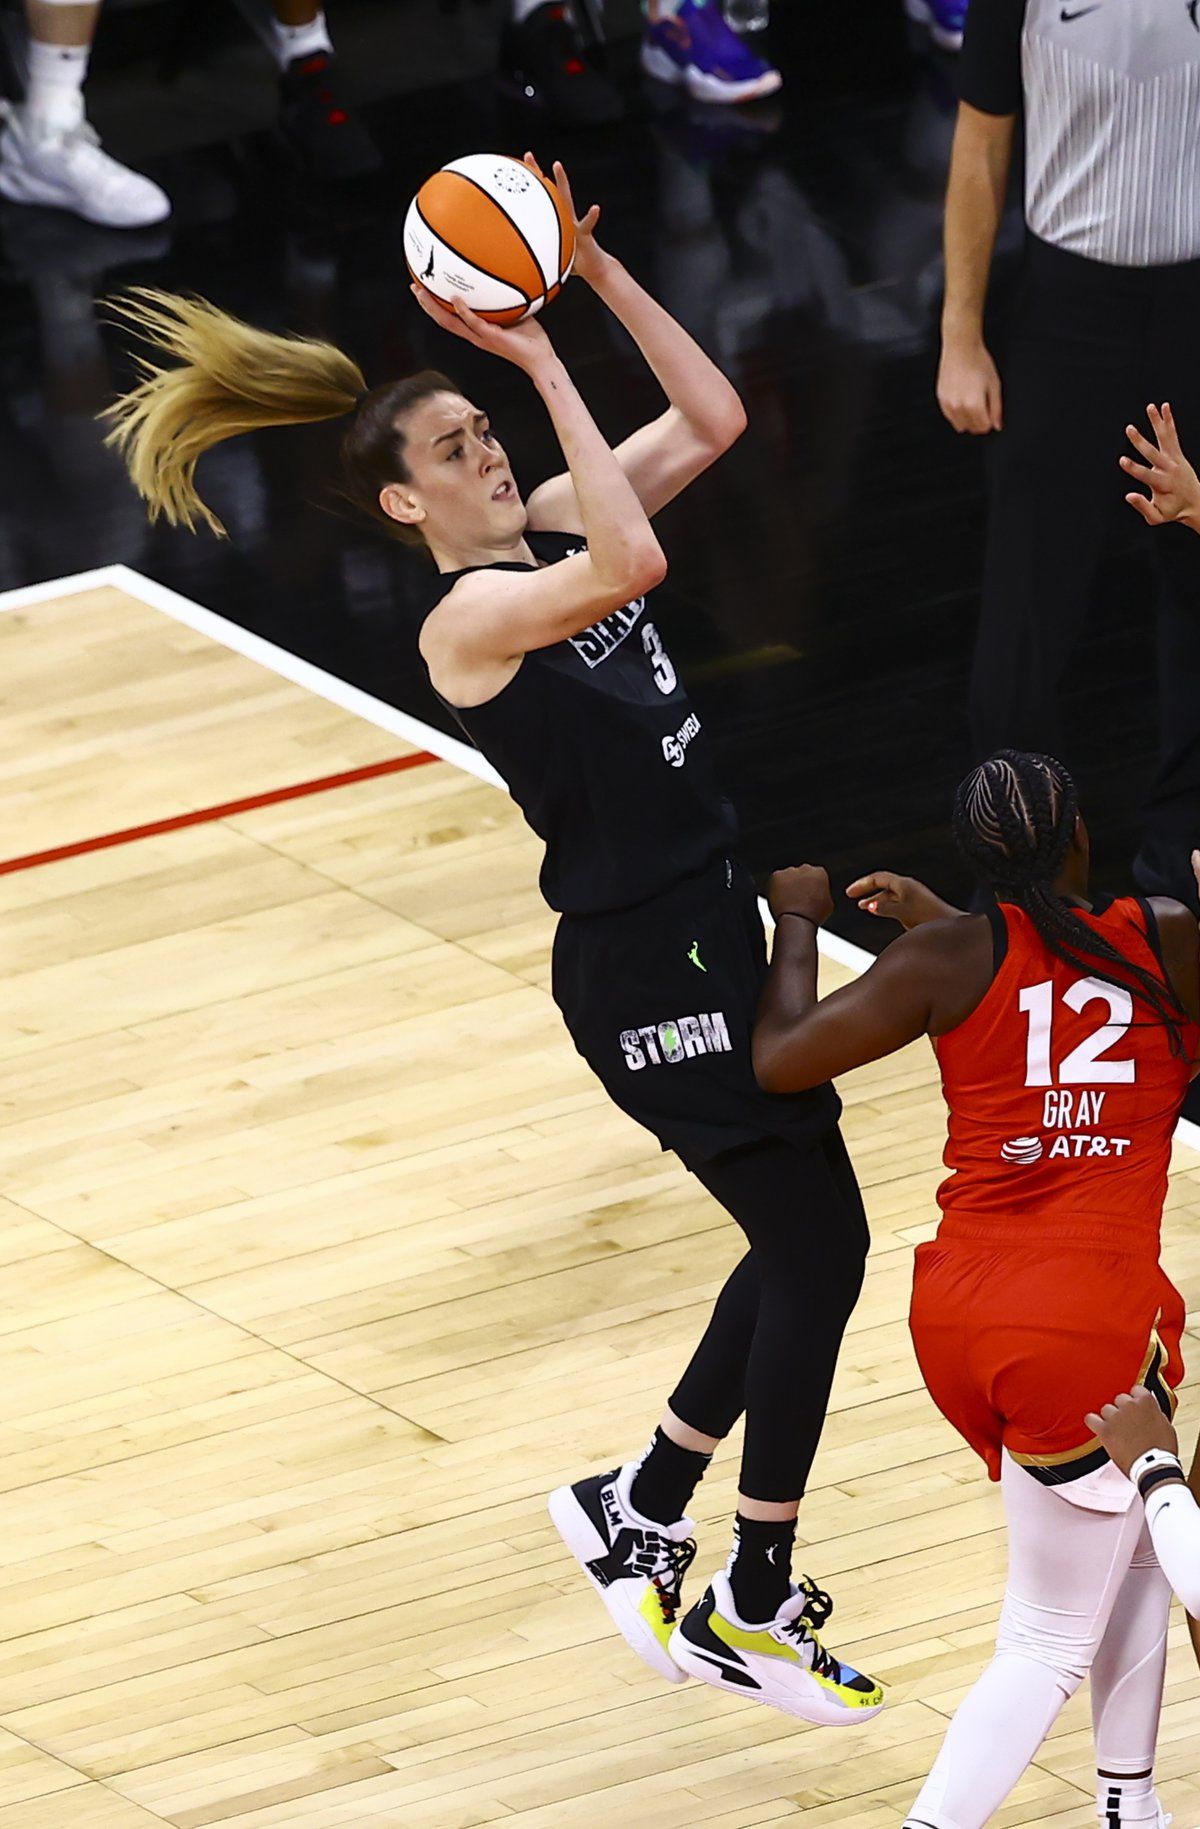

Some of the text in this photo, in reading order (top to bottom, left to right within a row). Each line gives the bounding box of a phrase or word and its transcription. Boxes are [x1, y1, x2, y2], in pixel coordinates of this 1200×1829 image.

[641, 622, 677, 695] 3
[619, 1011, 733, 1071] STORM
[1019, 976, 1136, 1087] 12
[1042, 1090, 1106, 1129] GRAY
[1048, 1134, 1132, 1159] AT&T
[601, 1489, 623, 1526] BLM
